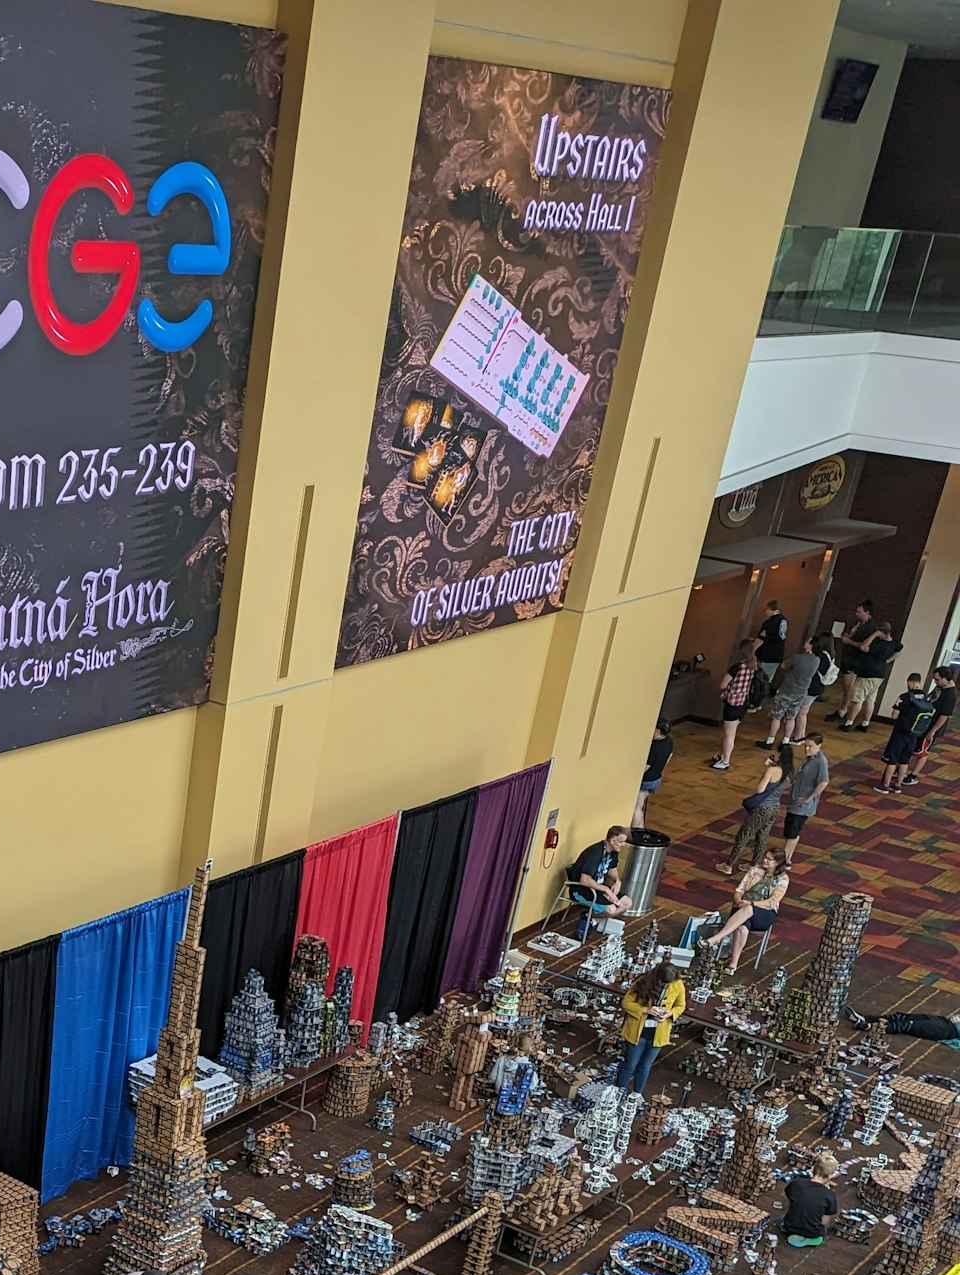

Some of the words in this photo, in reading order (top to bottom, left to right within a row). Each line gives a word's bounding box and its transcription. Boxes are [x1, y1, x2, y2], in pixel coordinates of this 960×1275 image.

[534, 113, 646, 183] UPSTAIRS
[524, 199, 584, 230] ACROSS
[585, 193, 623, 232] HALL
[56, 440, 196, 505] 235-239
[507, 517, 540, 557] THE
[538, 510, 576, 552] CITY
[78, 563, 175, 638] Hora
[410, 587, 437, 628] OF
[436, 574, 495, 621] SILVER
[495, 558, 565, 608] AWAITS!
[19, 658, 53, 693] City
[55, 657, 73, 680] of
[73, 642, 117, 675] Silver
